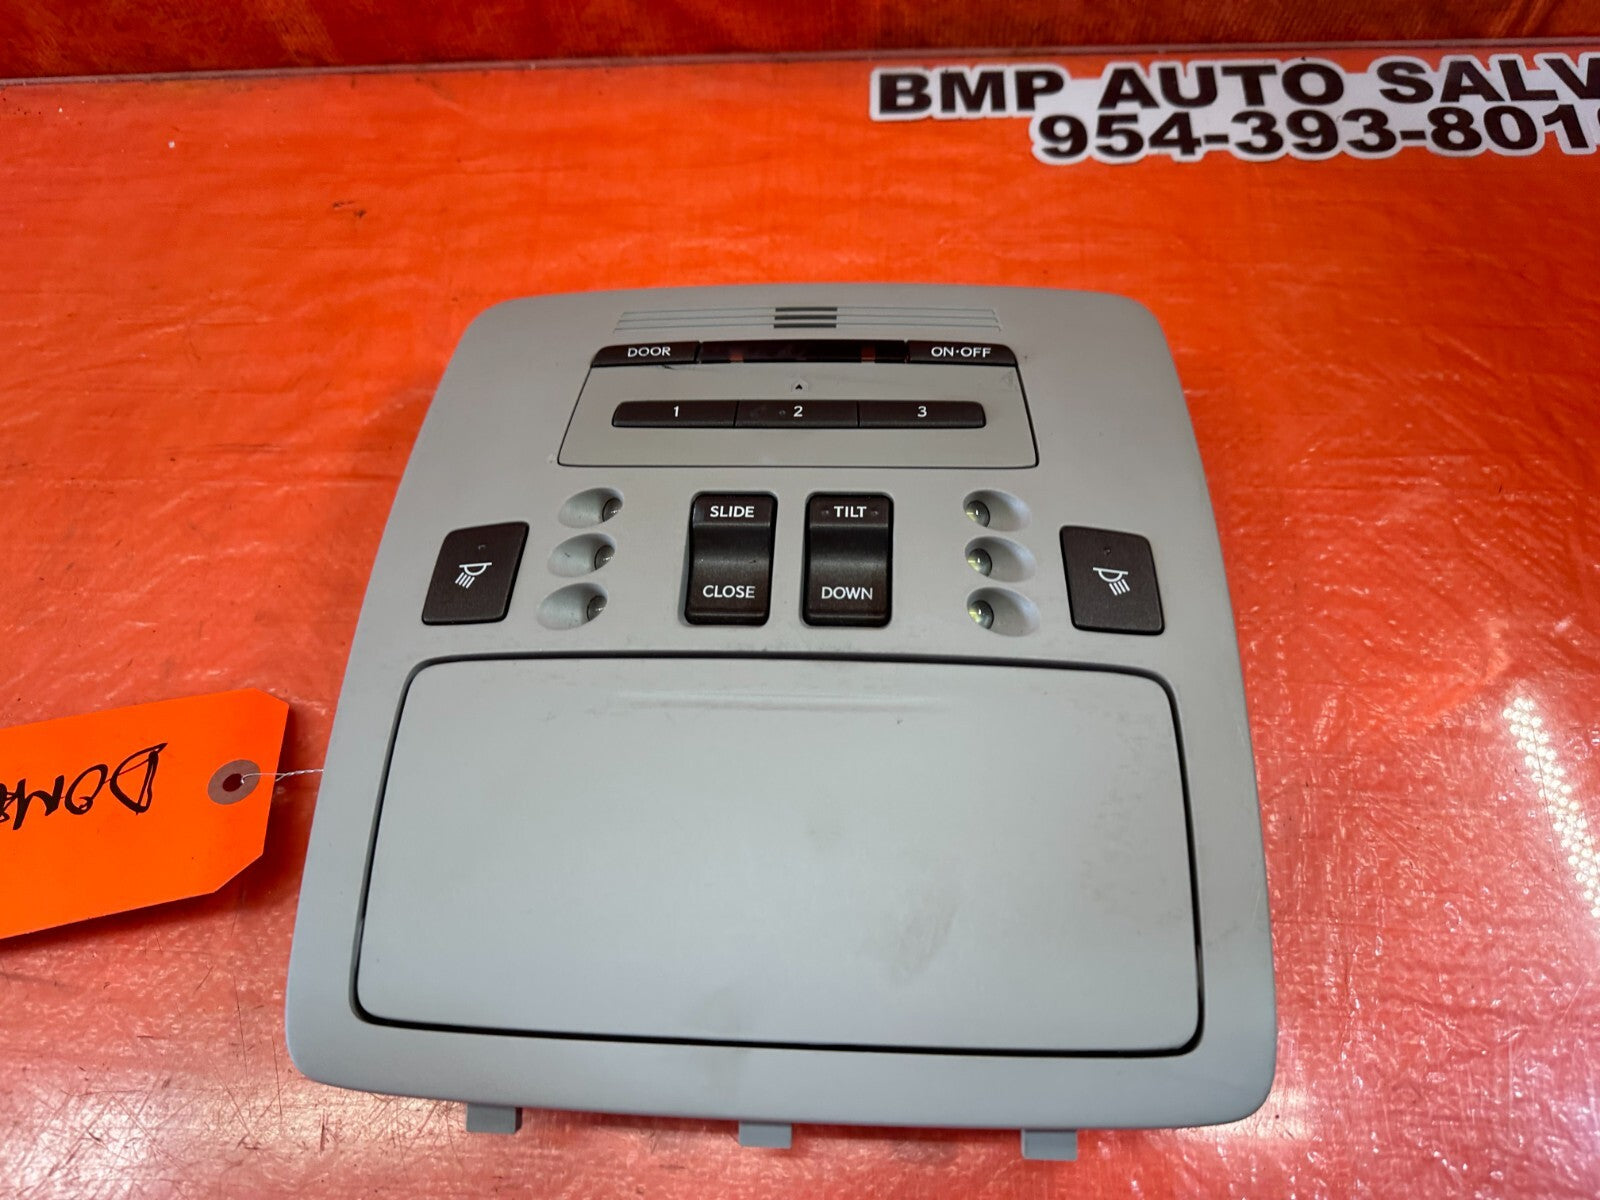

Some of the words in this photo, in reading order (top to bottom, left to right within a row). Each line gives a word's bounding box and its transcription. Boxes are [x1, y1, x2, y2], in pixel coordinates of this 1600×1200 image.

[877, 69, 1066, 114] BMP
[1096, 64, 1345, 109] AUTO
[1037, 104, 1600, 158] 954-393-801
[626, 345, 672, 358] DOOR
[672, 405, 680, 418] 1
[793, 405, 804, 418] 2
[916, 405, 928, 418] 3
[709, 505, 755, 518] SLIDE
[833, 505, 867, 518] TILT
[702, 584, 756, 599] CLOSE
[821, 586, 873, 600] DOWN
